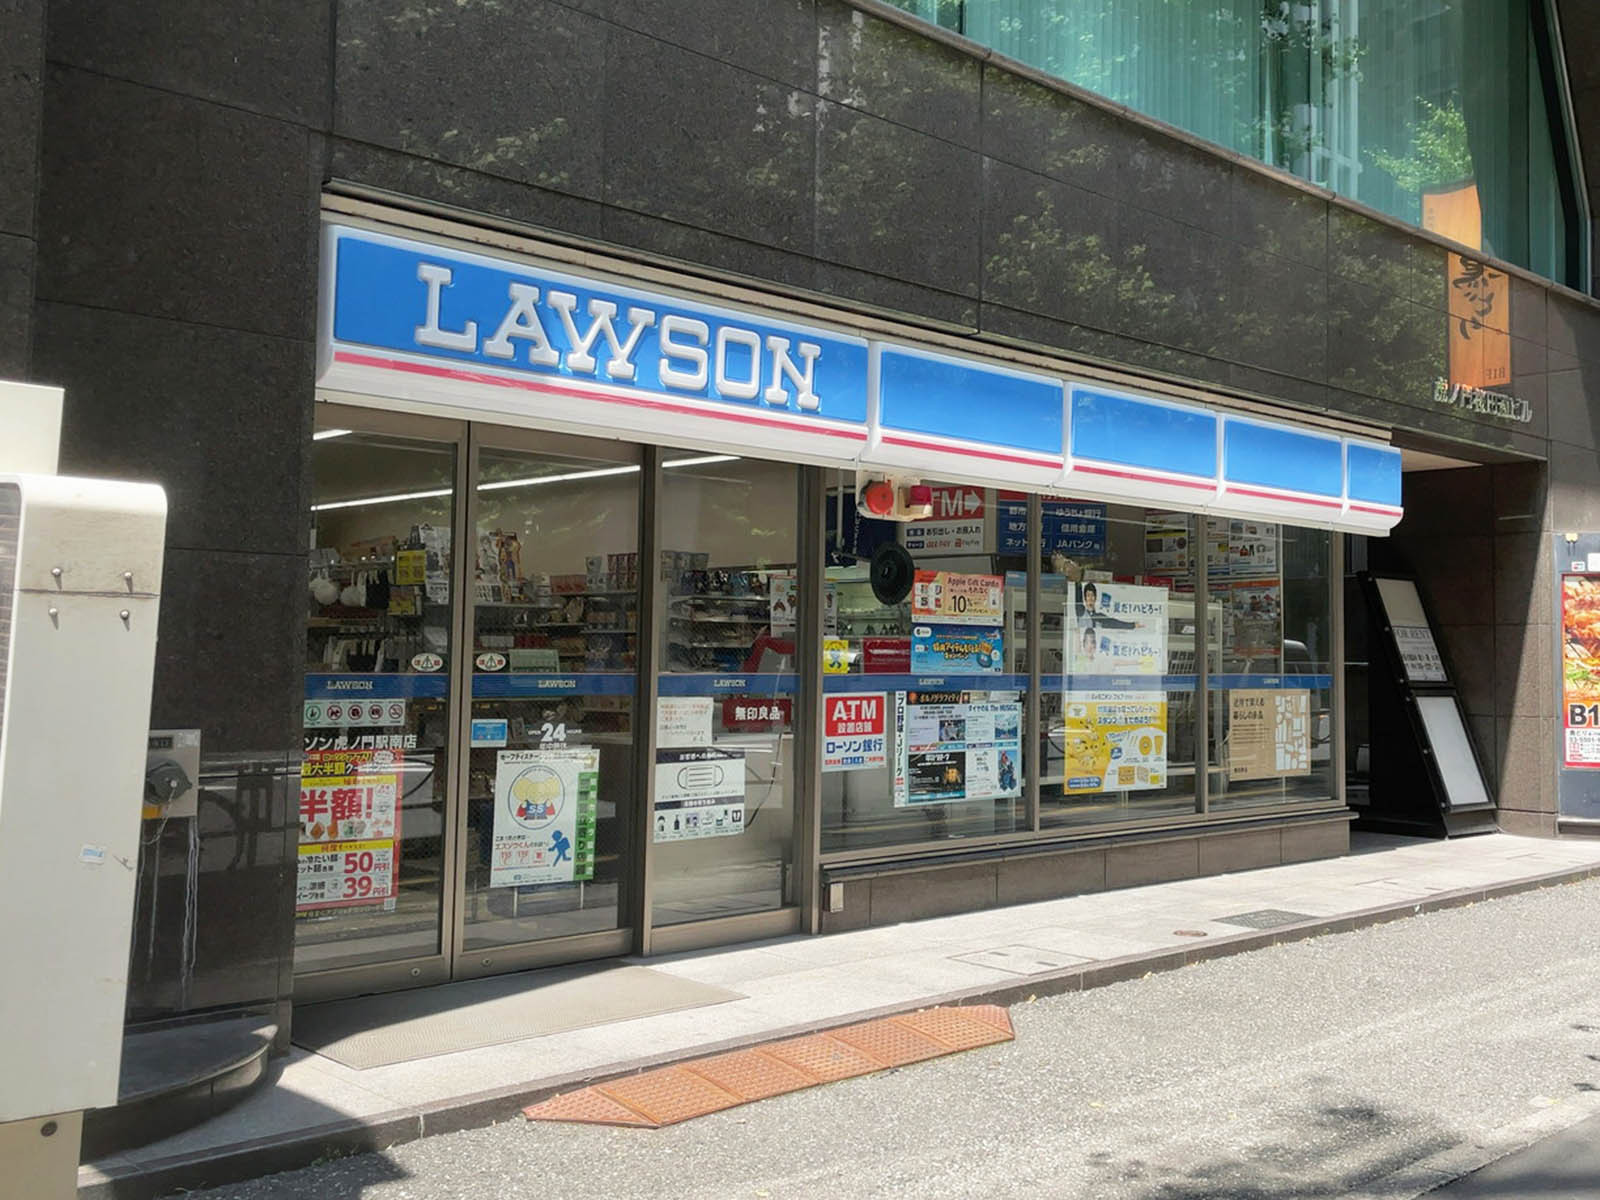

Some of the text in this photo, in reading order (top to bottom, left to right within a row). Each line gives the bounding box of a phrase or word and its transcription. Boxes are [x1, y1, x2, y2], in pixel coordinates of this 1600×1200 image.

[415, 261, 822, 413] LAWSON
[947, 576, 966, 588] Apple
[326, 680, 373, 690] LAWSON
[538, 680, 576, 688] LAWSON
[735, 706, 781, 721] 無印良品
[832, 699, 877, 721] ATM
[1569, 704, 1599, 726] B1
[541, 723, 567, 742] 24
[837, 722, 873, 733] 設置店舗
[826, 738, 884, 754] ローソン銀行
[299, 787, 374, 823] 半額!
[343, 852, 374, 875] 50
[342, 875, 373, 899] 39
